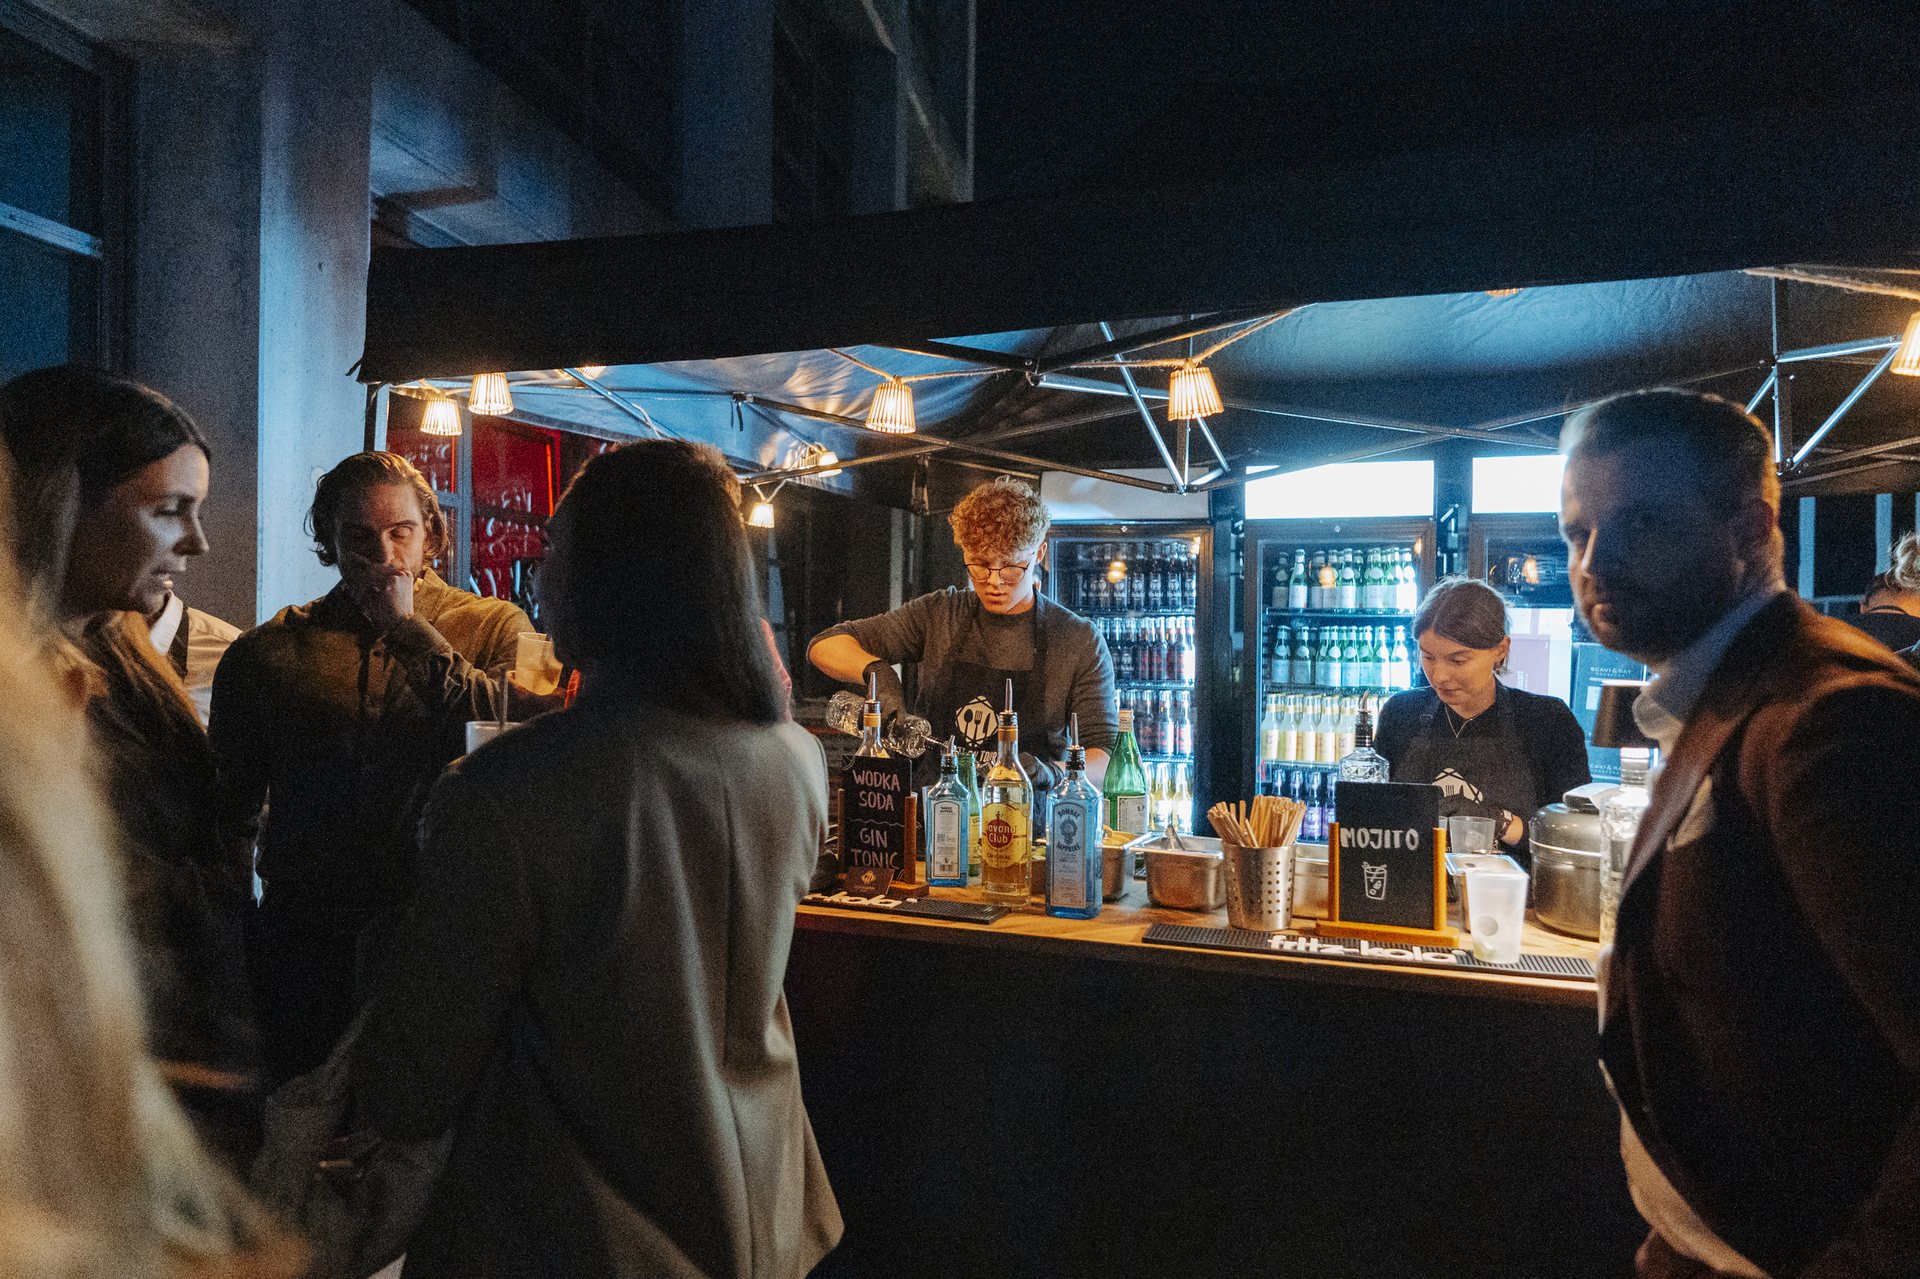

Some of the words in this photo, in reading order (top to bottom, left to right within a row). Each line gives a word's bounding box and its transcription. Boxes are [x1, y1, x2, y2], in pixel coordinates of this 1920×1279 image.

[852, 769, 900, 792] WODKA
[859, 791, 895, 811] SODA
[860, 827, 888, 848] GIN
[989, 833, 1008, 843] Club
[1340, 827, 1420, 851] MOJITO
[850, 848, 899, 870] TONIC
[1267, 934, 1458, 964] fritz-kola
